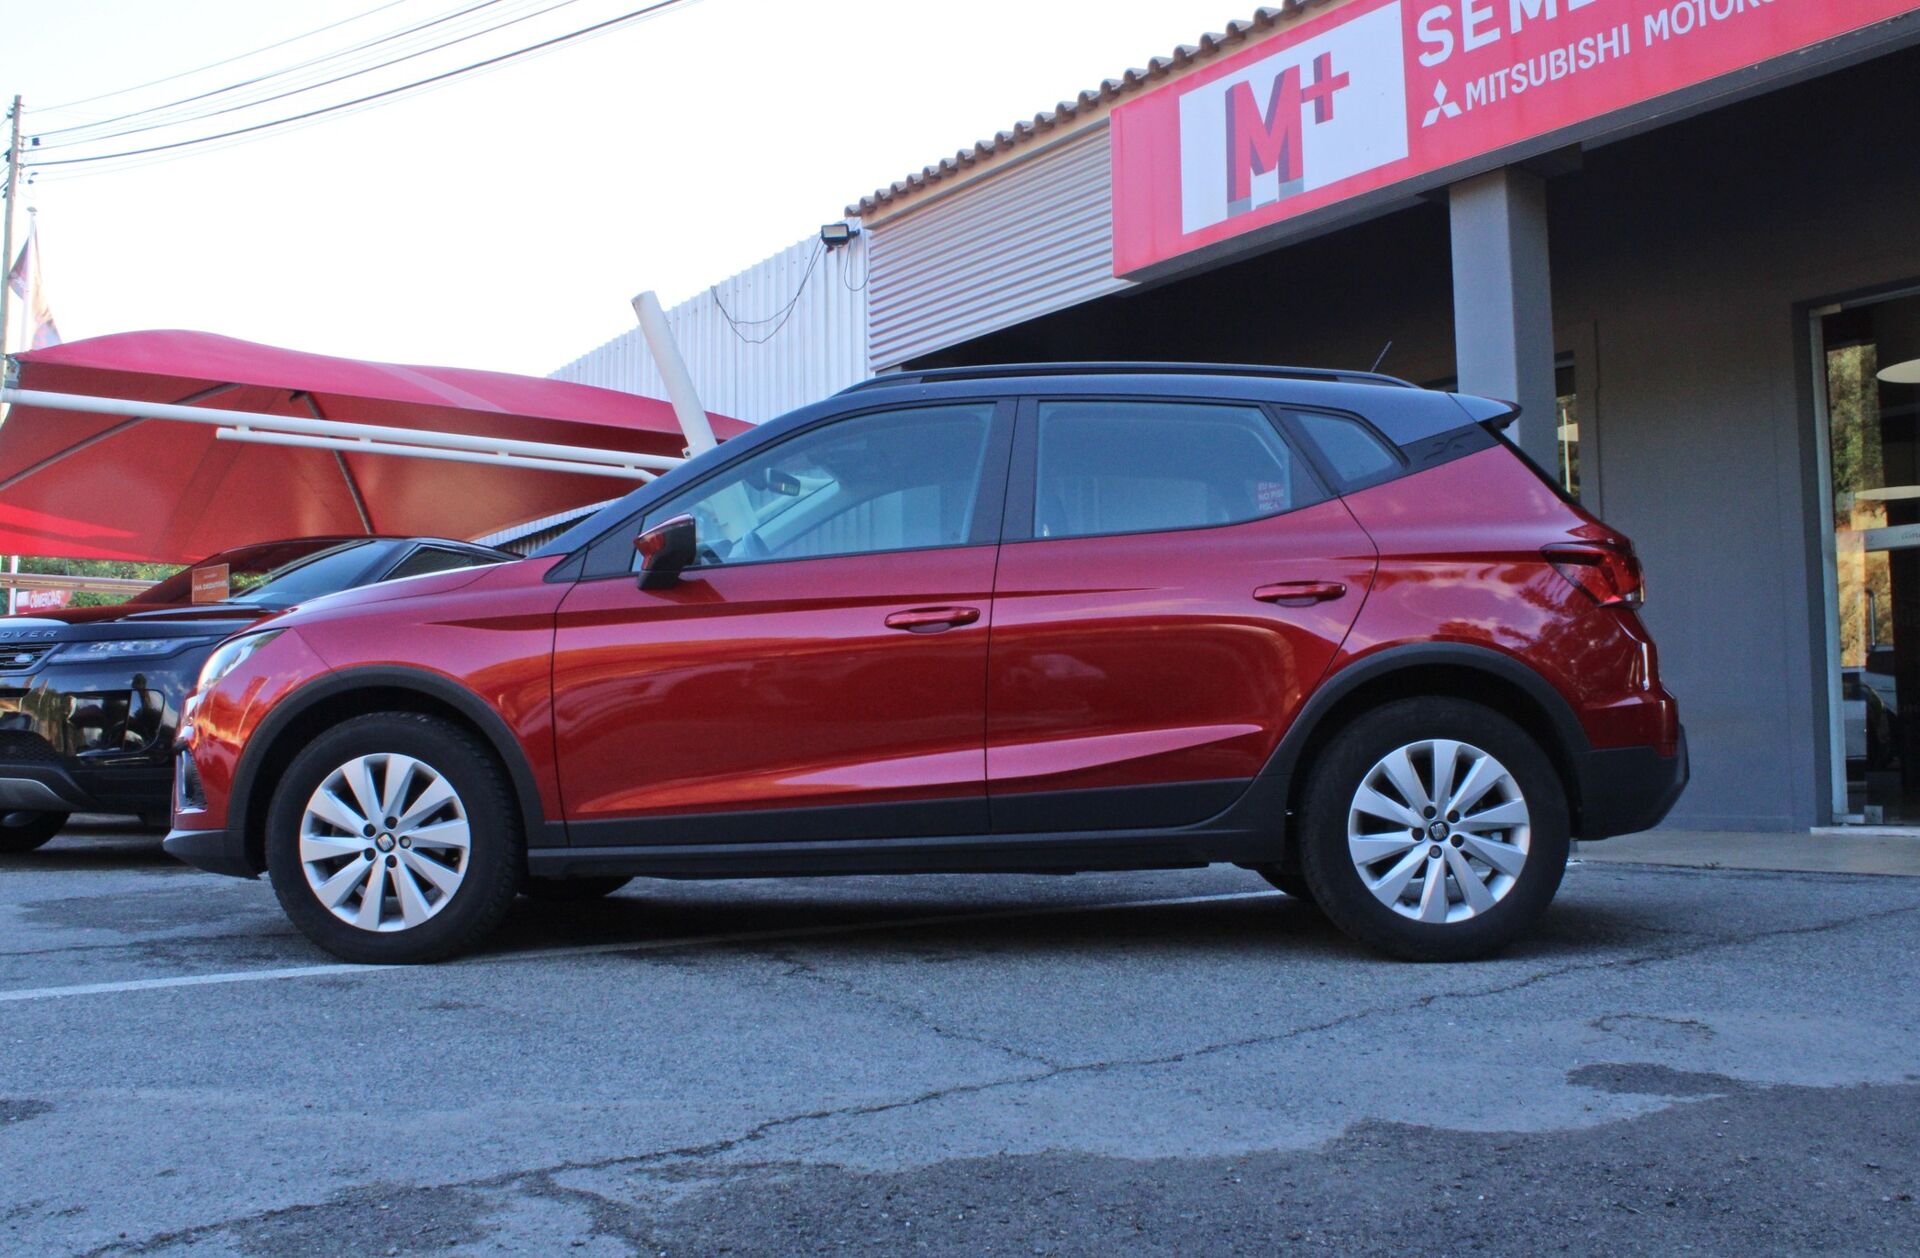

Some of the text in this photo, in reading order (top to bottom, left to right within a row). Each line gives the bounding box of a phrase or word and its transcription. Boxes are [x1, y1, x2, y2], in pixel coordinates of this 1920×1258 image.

[1418, 0, 1597, 67] SEM
[1465, 0, 1775, 111] MITSUBISHI MOTO
[1225, 51, 1349, 203] M+
